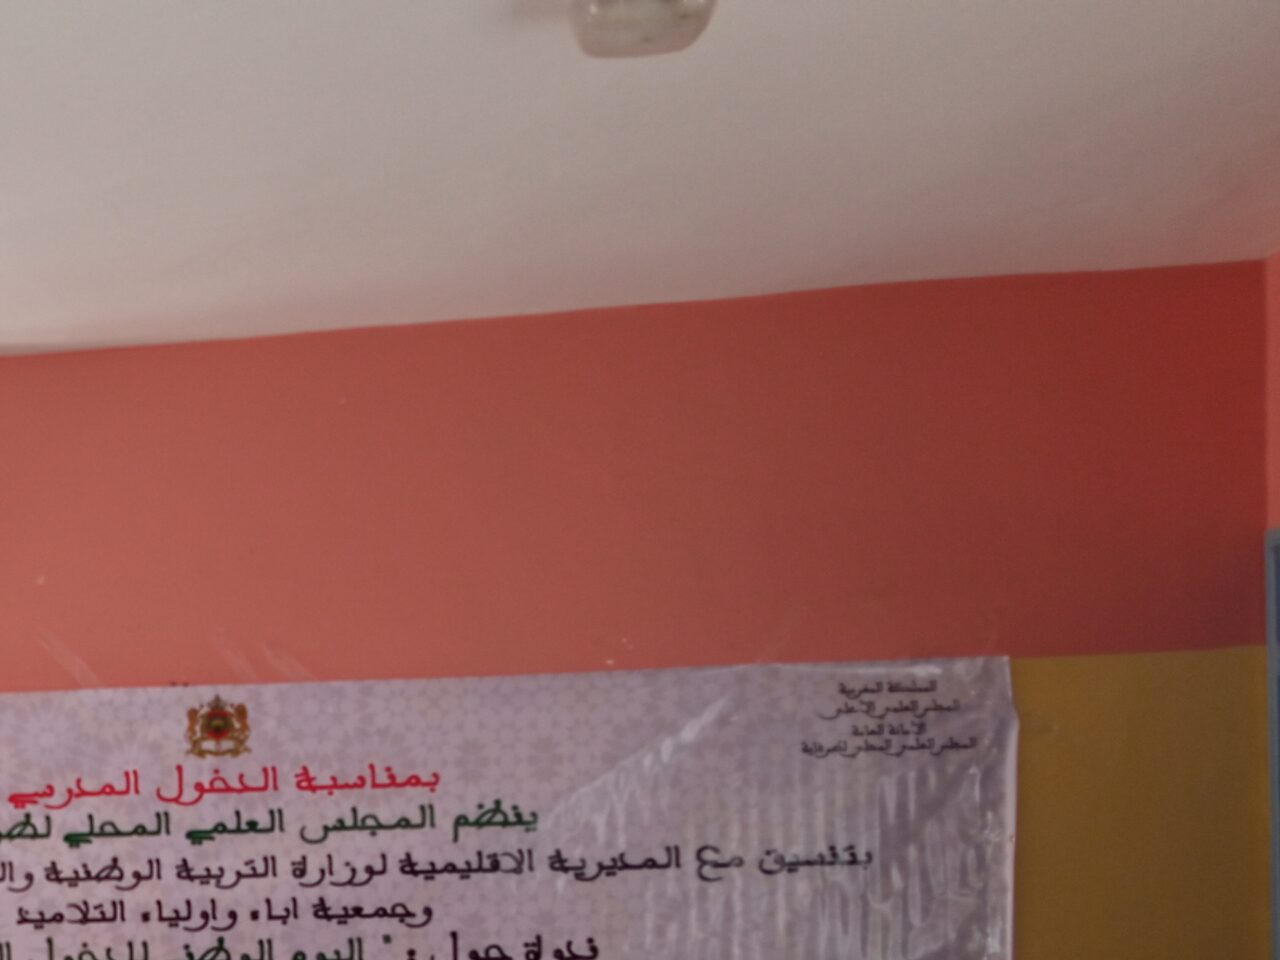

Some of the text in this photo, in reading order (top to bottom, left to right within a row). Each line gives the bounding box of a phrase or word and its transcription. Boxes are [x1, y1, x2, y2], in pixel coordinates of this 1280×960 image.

[8, 763, 440, 810] بمناسبة الدخول المدرسي
[63, 811, 170, 848] المحلي
[185, 809, 284, 845] العلمي
[300, 804, 435, 844] المجلس
[453, 799, 538, 843] ينظم
[45, 857, 161, 891] الوطنية
[176, 856, 277, 889] التربية
[291, 853, 387, 887] لوزارة
[399, 849, 533, 880] الاقليمية
[549, 845, 681, 882] المديرية
[696, 845, 744, 882] مع
[759, 845, 873, 875] بتنسيق
[17, 900, 125, 929] التلاميذ
[250, 897, 298, 925] اباء
[312, 897, 432, 928] وجمعية
